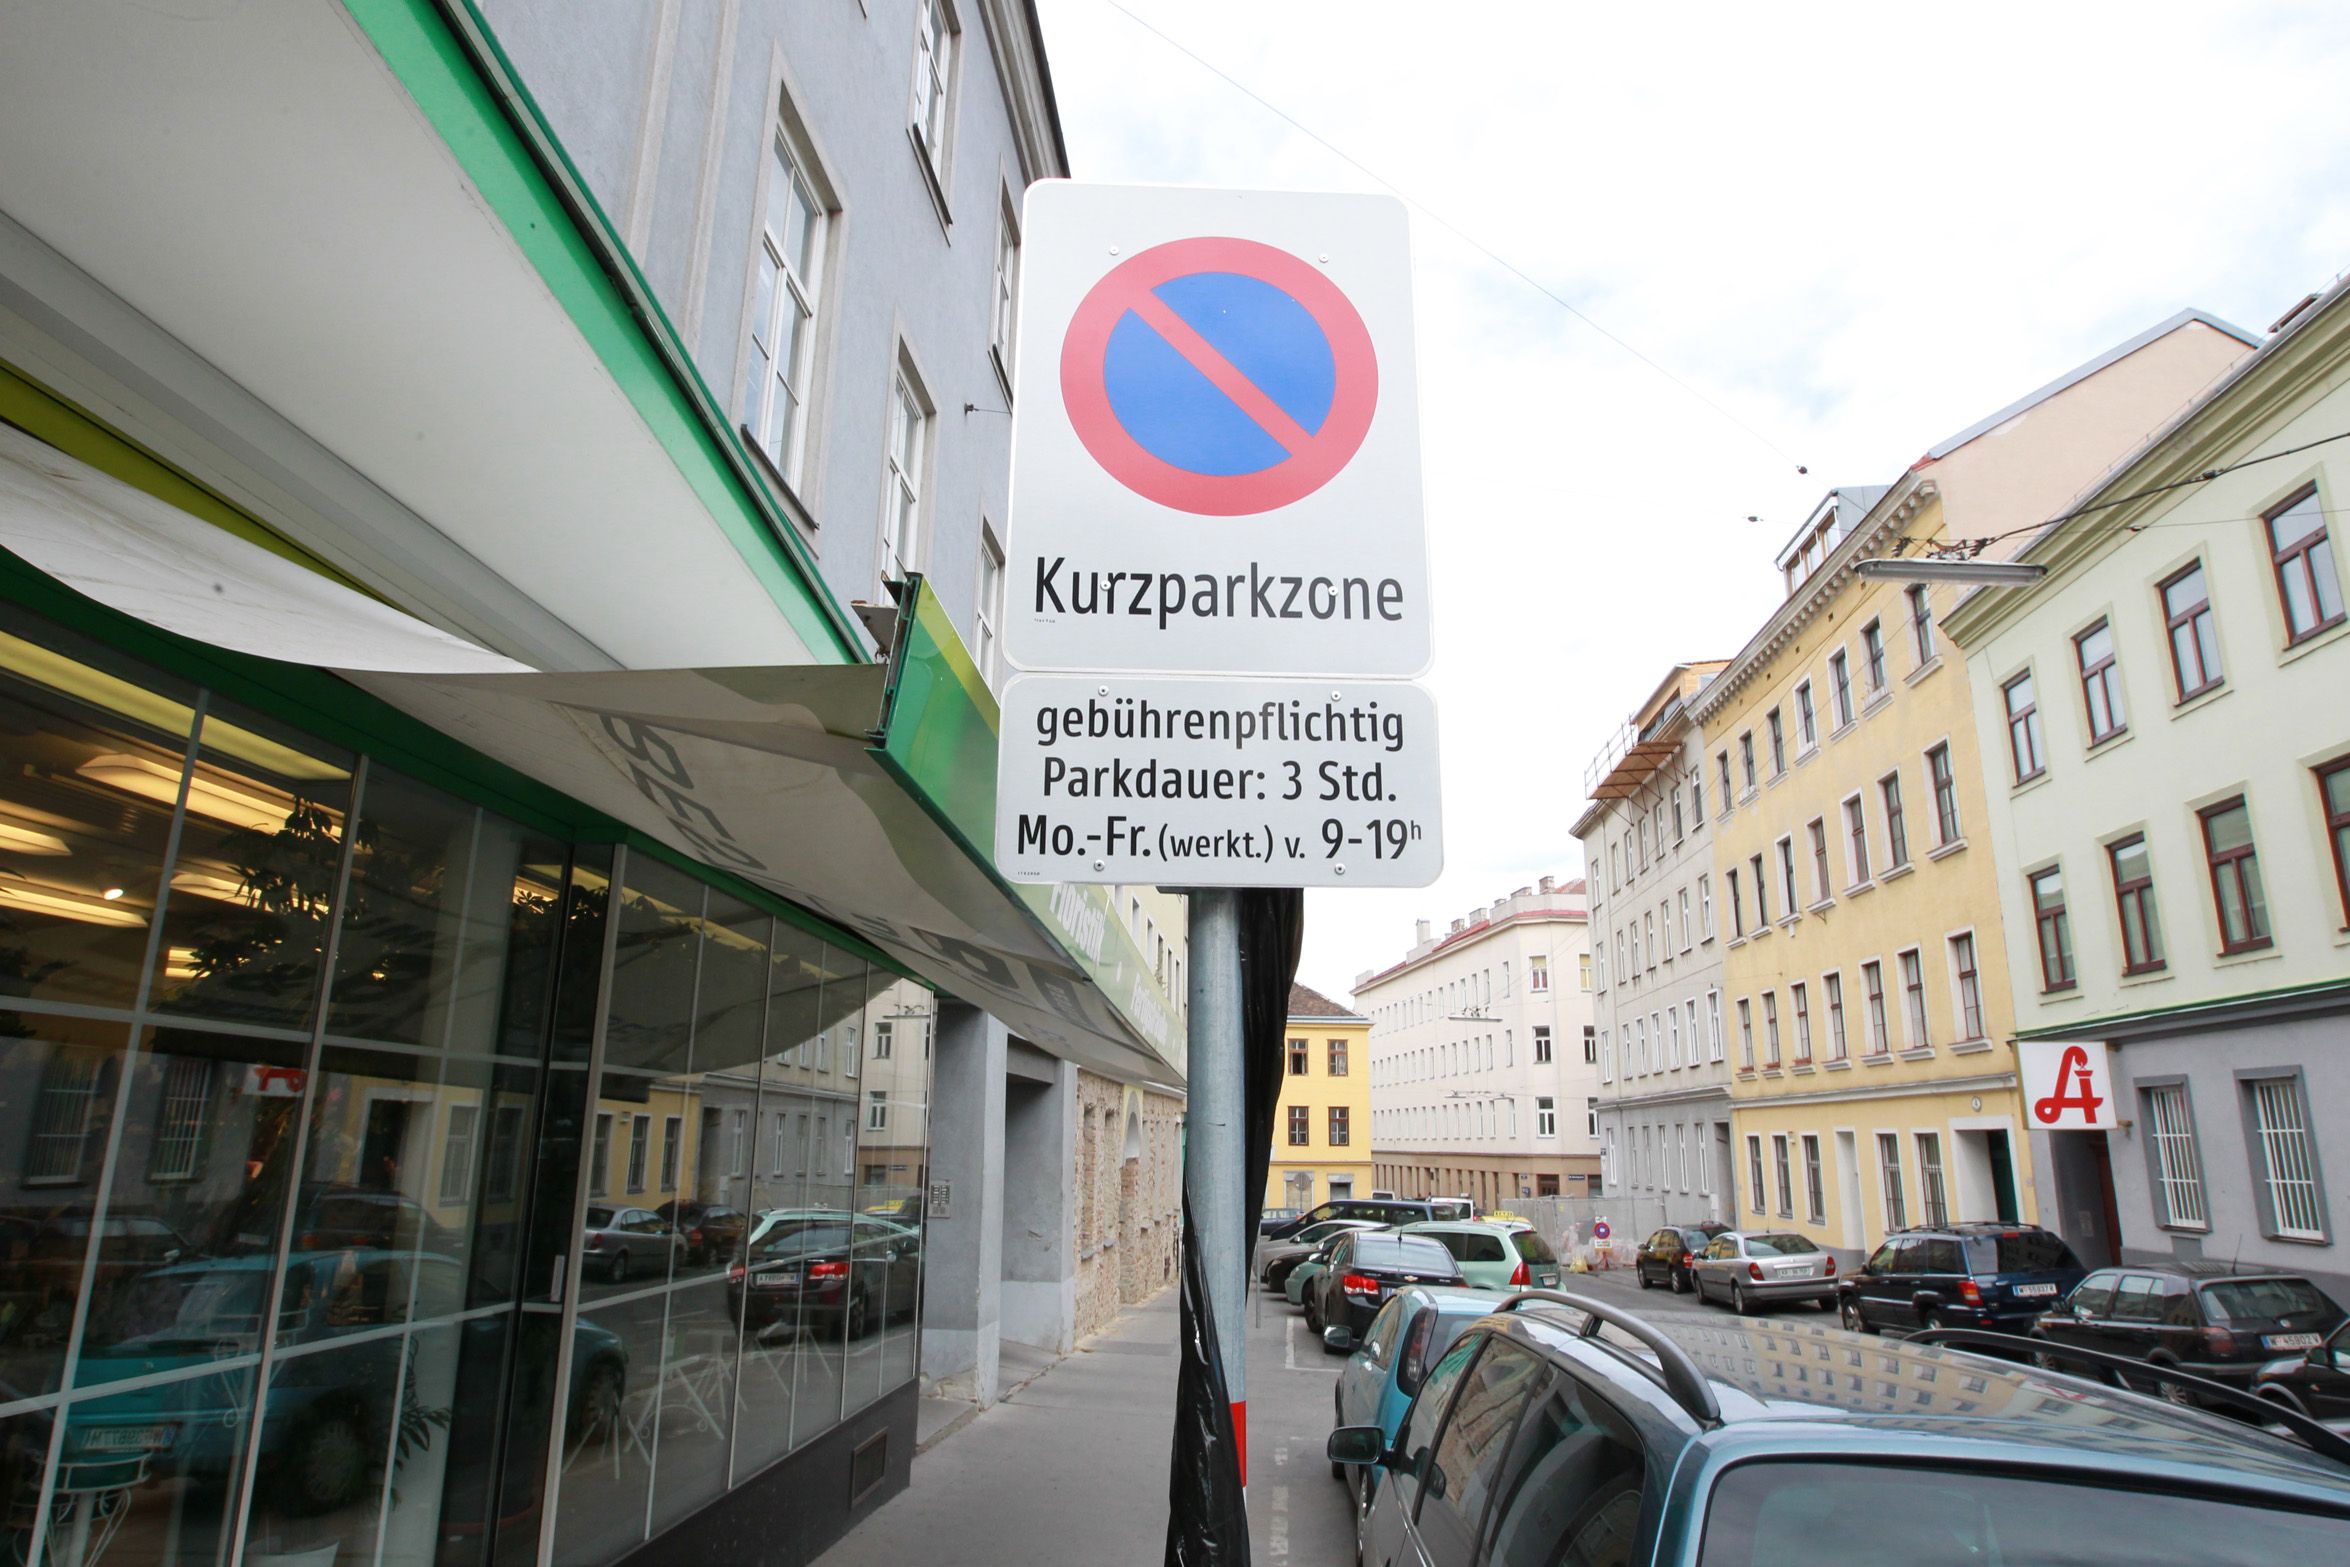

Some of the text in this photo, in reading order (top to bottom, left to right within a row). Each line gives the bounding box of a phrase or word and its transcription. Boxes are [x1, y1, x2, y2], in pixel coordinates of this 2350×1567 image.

[1036, 557, 1402, 629] Kurzparkzone
[1037, 699, 1402, 751] gebührenpflichtig
[1044, 757, 1396, 801] Parkdauer: 3 Std.
[1285, 838, 1305, 858] v.
